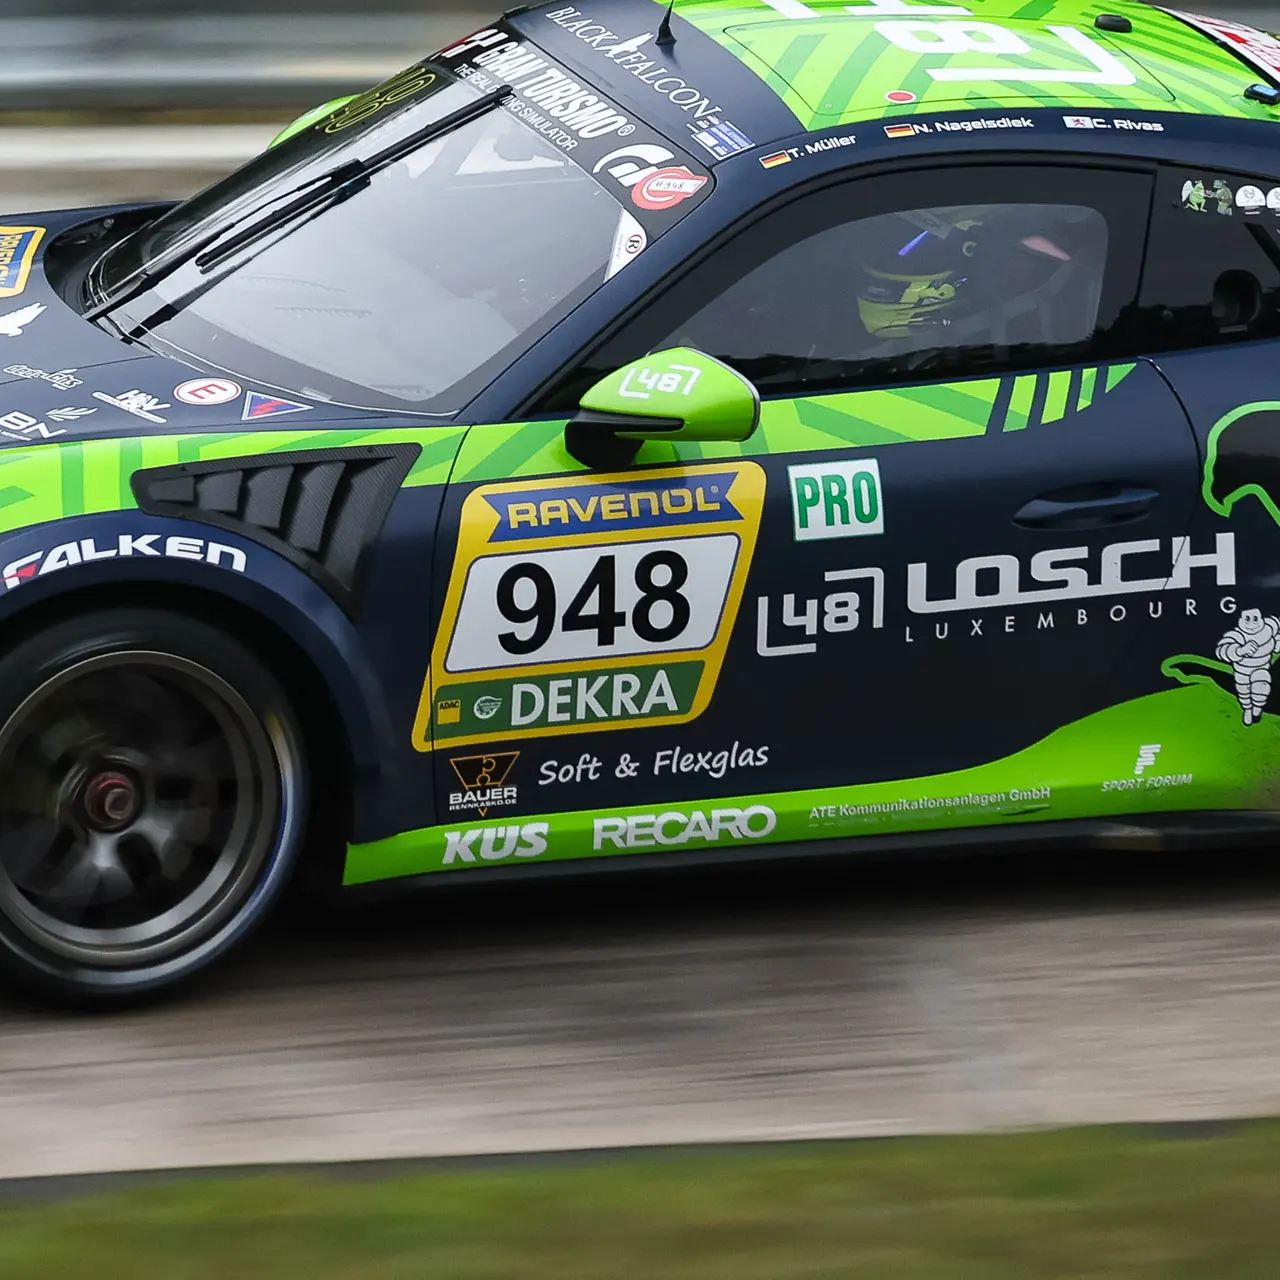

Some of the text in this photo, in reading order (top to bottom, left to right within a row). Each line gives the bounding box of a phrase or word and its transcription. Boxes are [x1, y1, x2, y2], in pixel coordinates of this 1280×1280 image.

[472, 41, 550, 83] GRAN
[545, 6, 723, 119] BLACK FALCON
[453, 63, 477, 81] THE
[467, 70, 492, 92] REAL
[518, 107, 579, 151] SIMULATOR
[914, 117, 1035, 134] N. Nagelsdiek
[1093, 118, 1164, 132] C. Rivas
[788, 134, 857, 159] T. Müller
[796, 470, 880, 530] PRO
[0, 534, 247, 590] FALKEN
[907, 531, 1237, 614] LOSCH
[495, 549, 691, 656] 948
[905, 596, 1238, 643] LUXEMBOURG
[439, 701, 460, 710] ADAC
[510, 669, 679, 727] DEKRA
[538, 741, 770, 786] Soft & Flexglas
[1101, 773, 1194, 793] SPORT FORUM
[449, 786, 518, 805] BAUER
[449, 799, 518, 811] RENNKASKO.DE
[809, 805, 836, 819] ATE
[839, 792, 1006, 817] Kommunikationsanlagen
[1009, 787, 1051, 802] GmbH
[441, 821, 549, 866] KÜS
[593, 804, 777, 851] RECARO
